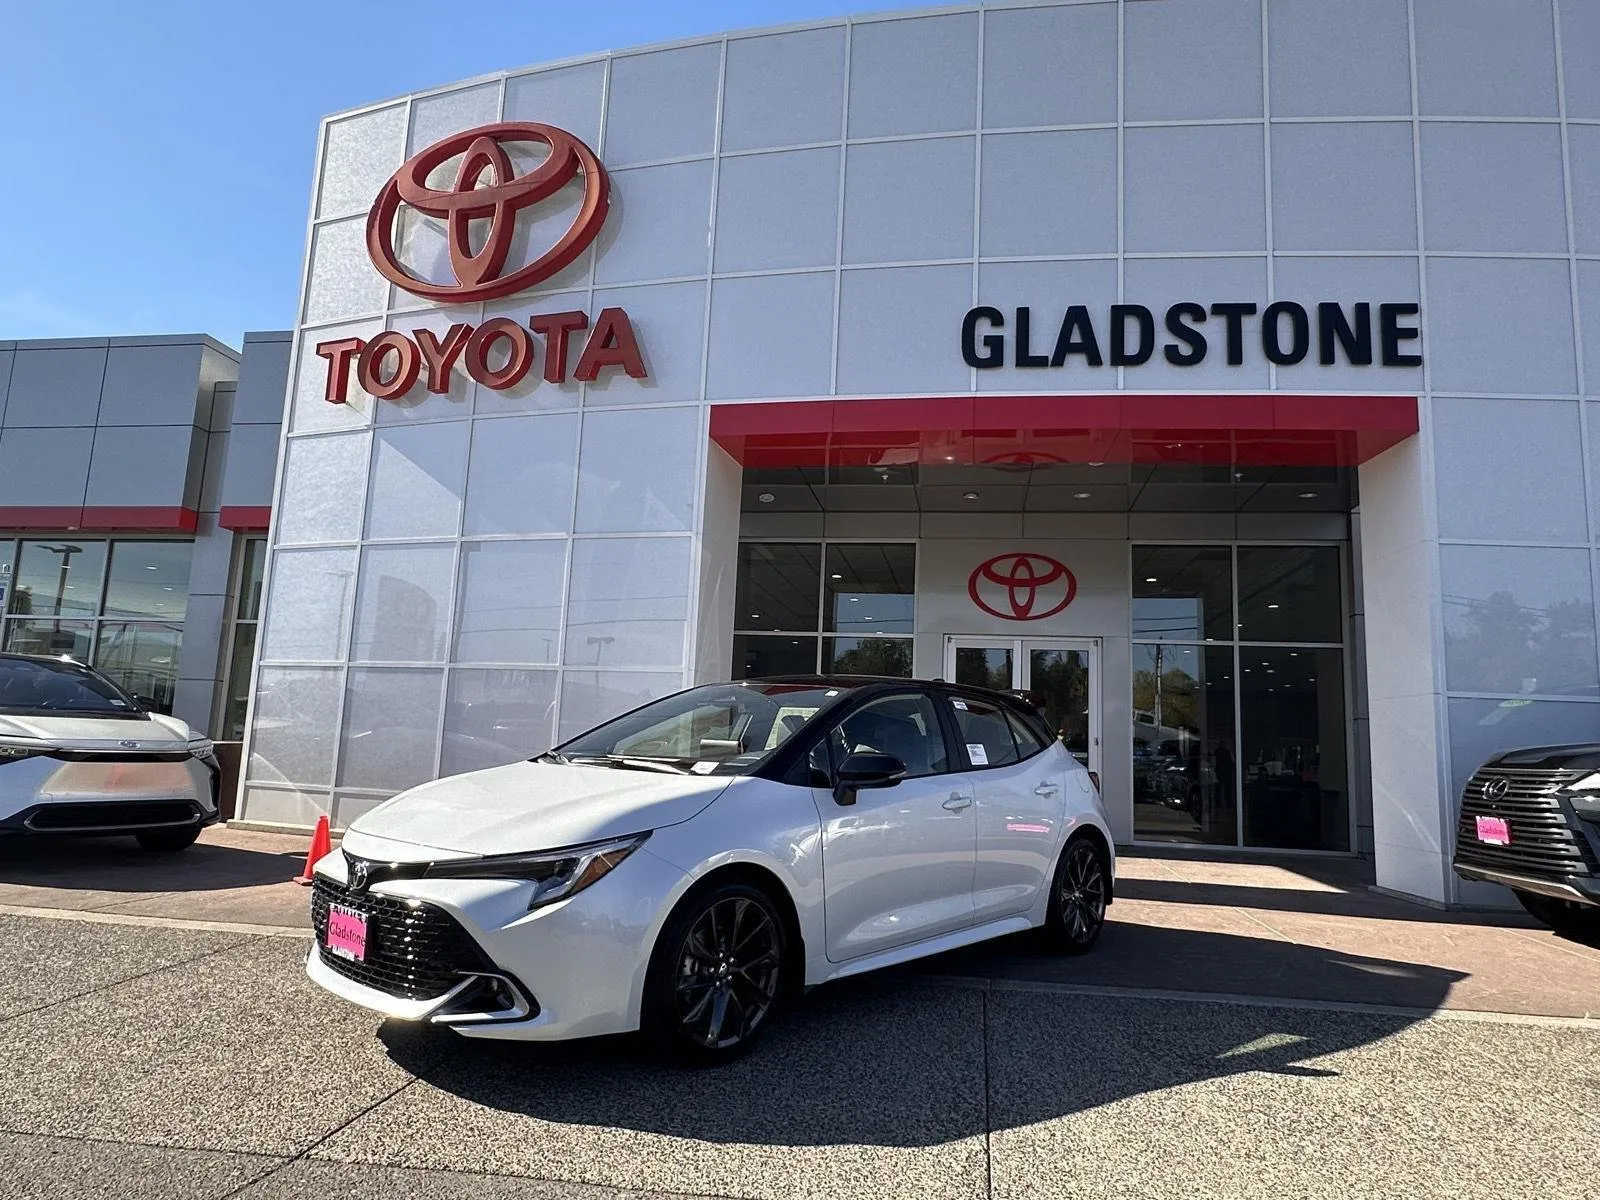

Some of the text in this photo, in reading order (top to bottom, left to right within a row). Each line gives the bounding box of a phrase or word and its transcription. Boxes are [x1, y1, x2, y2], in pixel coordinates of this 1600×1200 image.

[316, 307, 648, 404] TOYOTA
[961, 301, 1422, 369] GLADSTONE
[329, 921, 366, 947] Gladstone
